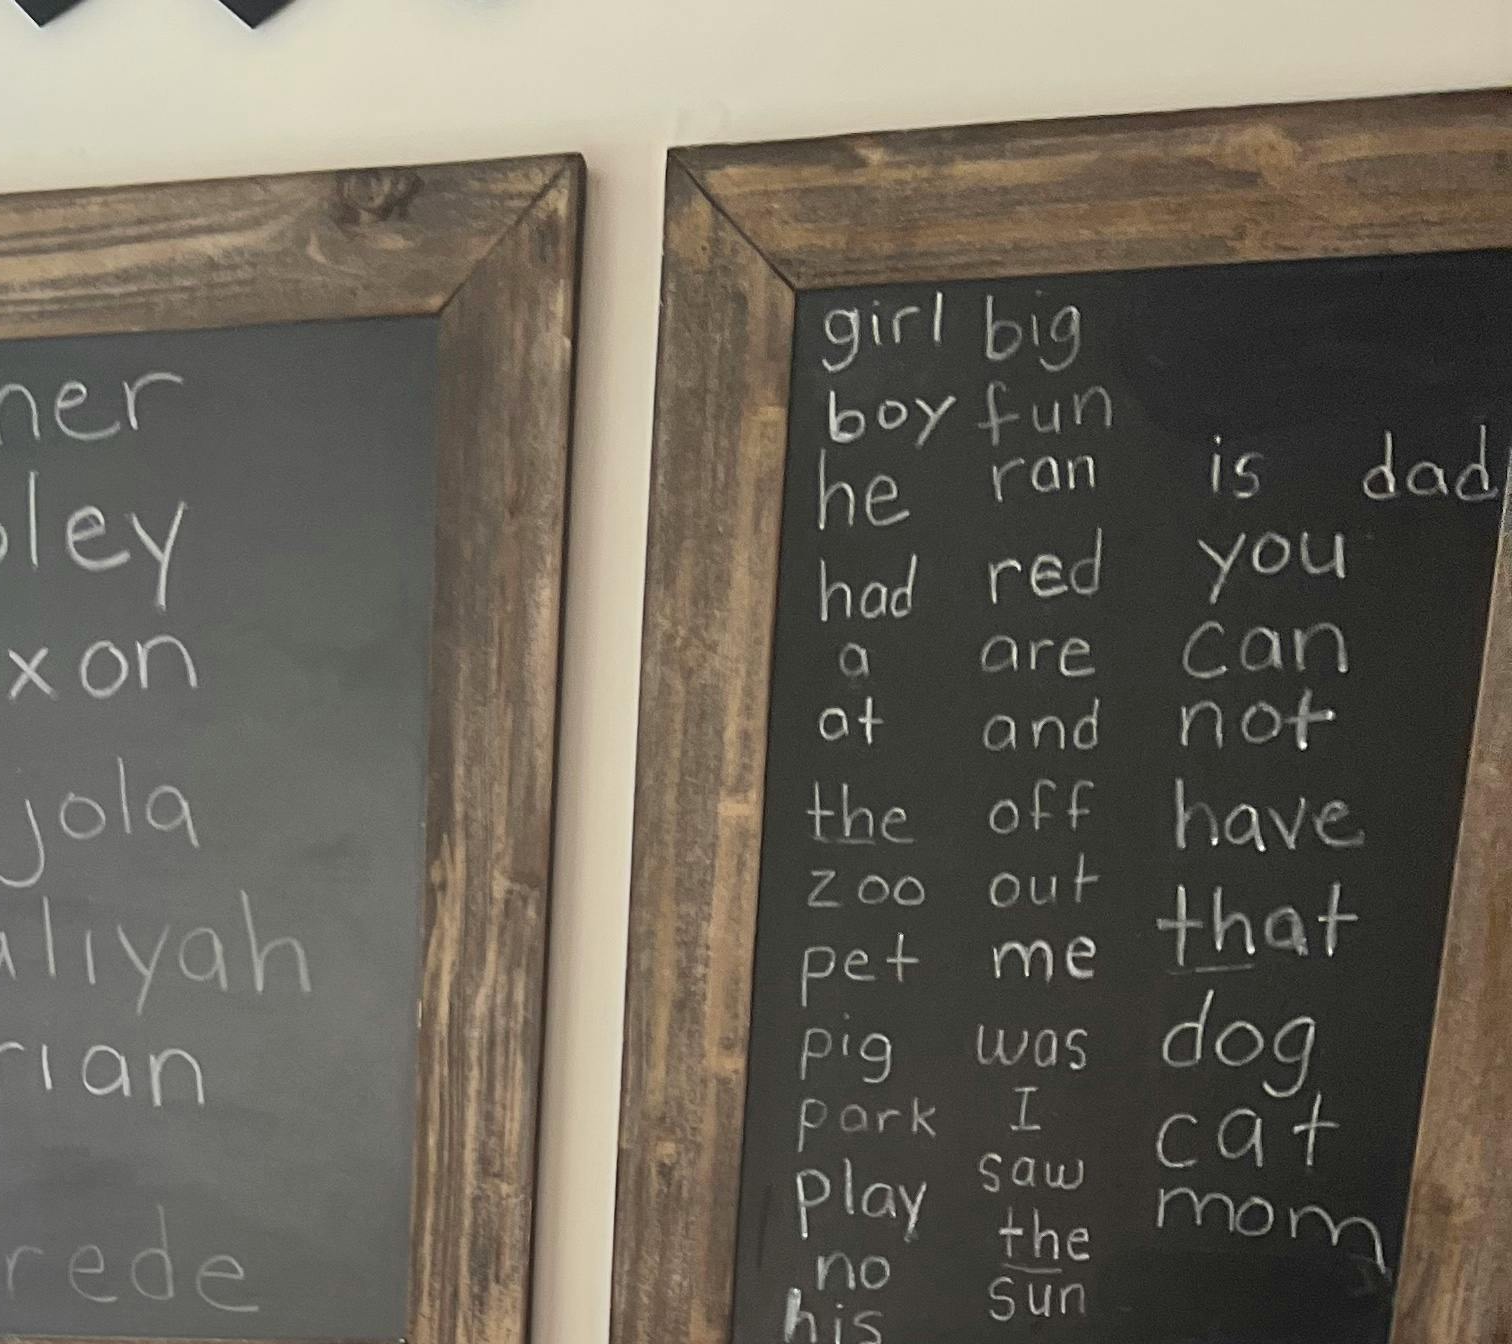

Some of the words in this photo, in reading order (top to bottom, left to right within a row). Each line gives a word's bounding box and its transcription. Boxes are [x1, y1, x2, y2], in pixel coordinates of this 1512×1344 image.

[821, 292, 944, 372] girl
[986, 291, 1081, 372] big
[828, 390, 956, 445] boy
[979, 382, 1112, 447] fun
[817, 449, 911, 531] he
[992, 451, 1095, 502] ran
[1210, 435, 1264, 498] is
[1363, 425, 1499, 500] dad
[819, 553, 917, 622] had
[989, 527, 1102, 604] red
[1198, 530, 1347, 604] you
[839, 643, 869, 678] a
[982, 635, 1096, 678] are
[1182, 621, 1349, 678] can
[819, 697, 884, 744] at
[984, 698, 1100, 750] and
[1179, 688, 1336, 752] not
[805, 781, 909, 828] the
[988, 780, 1095, 834] off
[1174, 779, 1365, 851] have
[806, 870, 926, 908] zoo
[990, 853, 1098, 908] out
[1157, 883, 1358, 966] that
[801, 932, 918, 1006] pet
[993, 935, 1096, 983] me
[801, 1015, 892, 1083] pig
[977, 1024, 1088, 1070] was
[1163, 989, 1316, 1097] dog
[798, 1098, 936, 1153] park
[1011, 1086, 1040, 1131] I
[1156, 1092, 1340, 1169] cat
[795, 1159, 927, 1243] play
[979, 1153, 1085, 1193] saw
[999, 1207, 1090, 1263] the
[1157, 1186, 1387, 1274] mom
[817, 1253, 891, 1291] no
[989, 1278, 1086, 1320] sun
